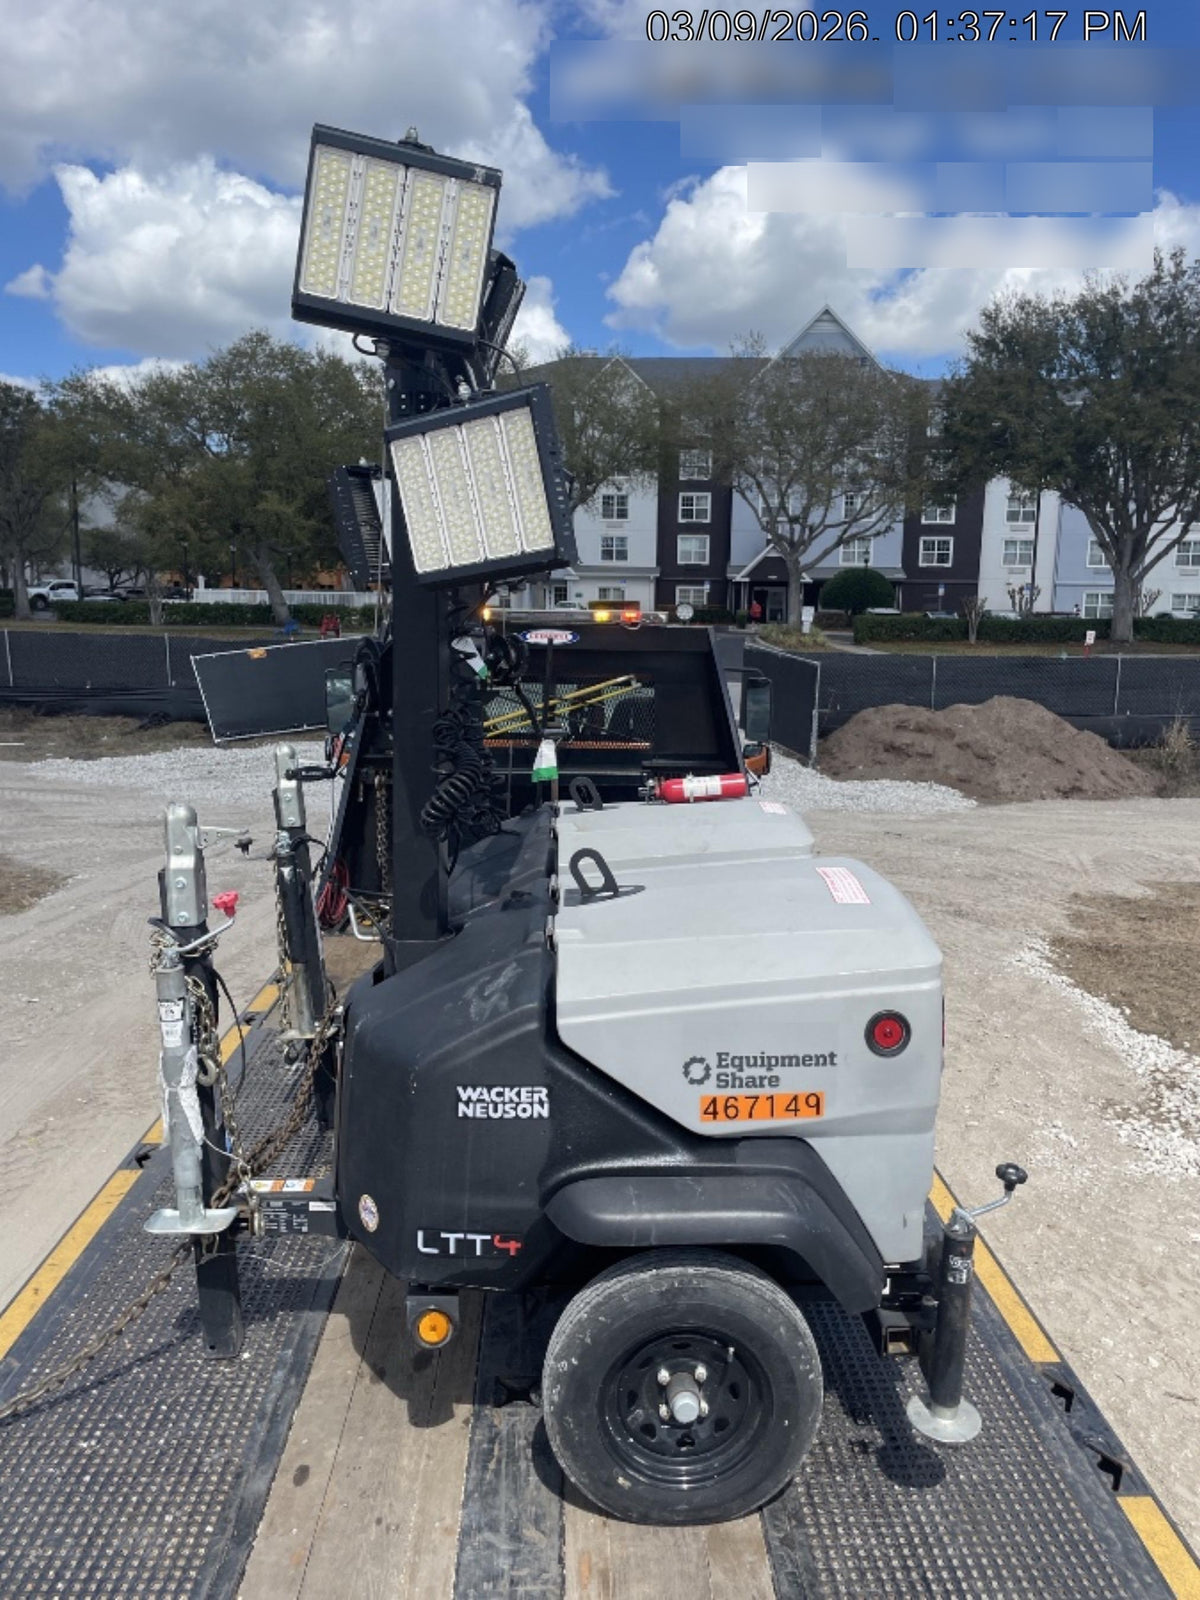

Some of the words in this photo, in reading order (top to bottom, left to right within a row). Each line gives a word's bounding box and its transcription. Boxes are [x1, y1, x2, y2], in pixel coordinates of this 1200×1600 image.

[716, 1051, 837, 1071] Equipment
[716, 1071, 780, 1089] Share
[457, 1086, 548, 1102] WACKER
[458, 1102, 549, 1118] NEUSON
[703, 1093, 821, 1120] 467149
[417, 1230, 521, 1256] LTT4
